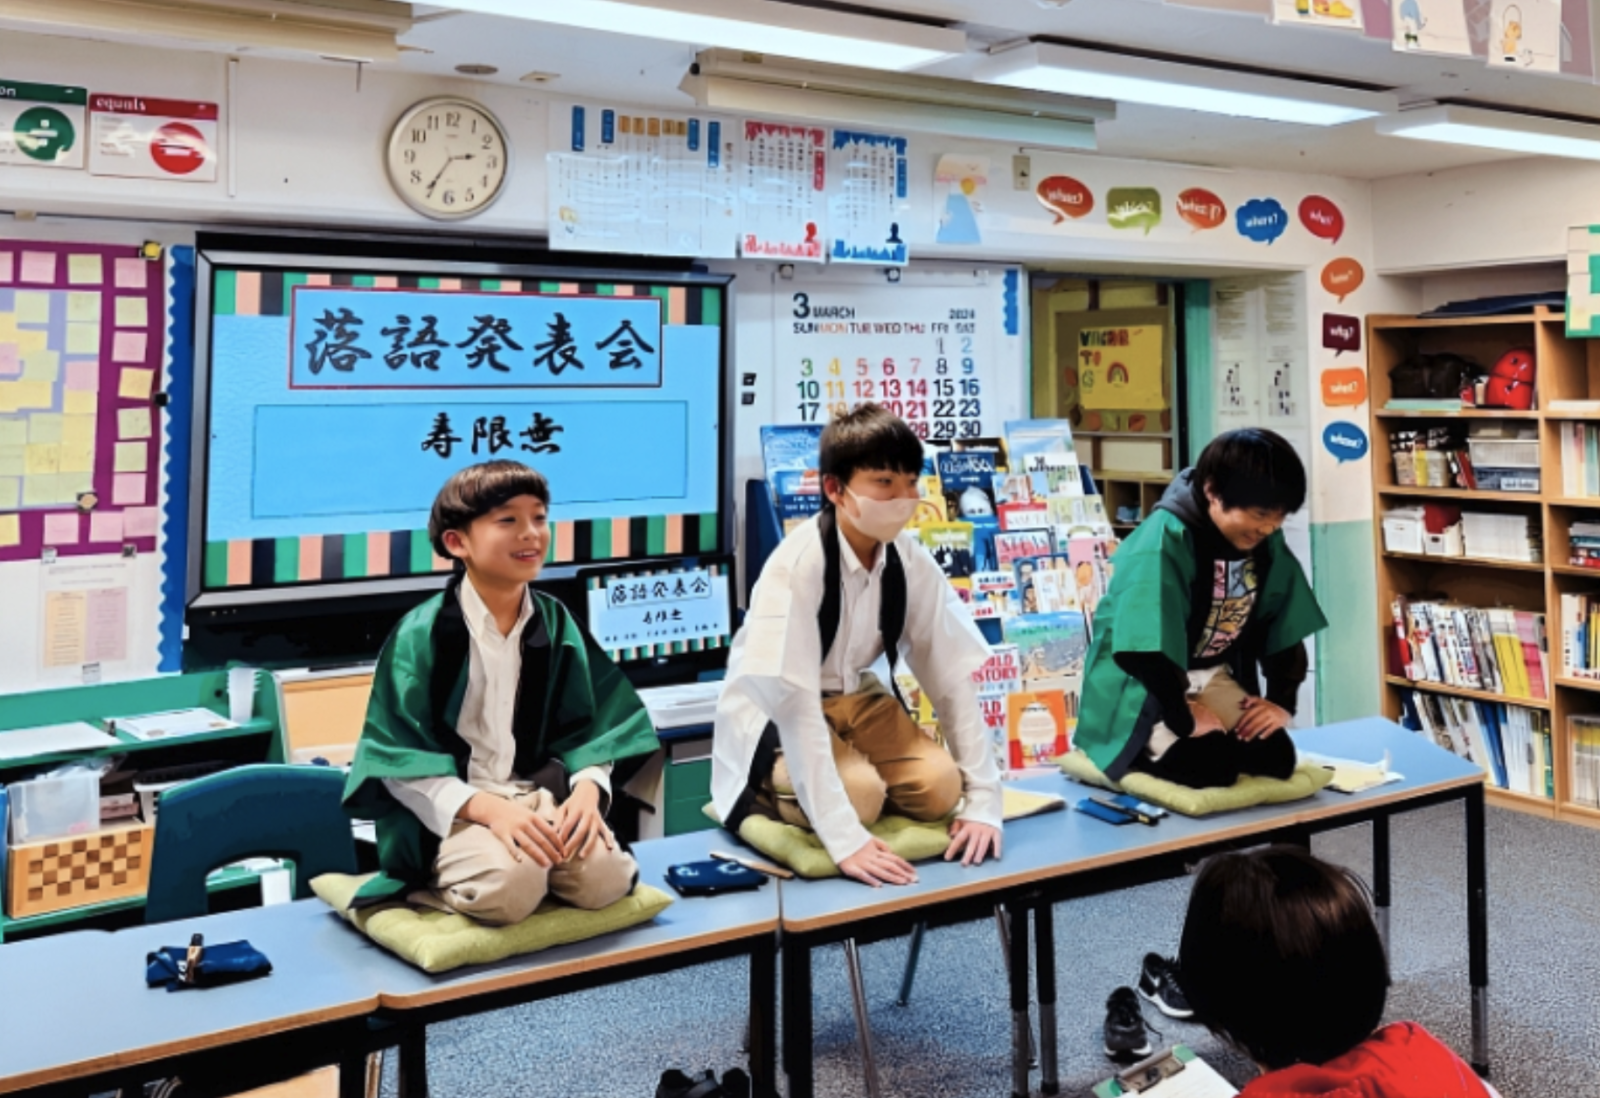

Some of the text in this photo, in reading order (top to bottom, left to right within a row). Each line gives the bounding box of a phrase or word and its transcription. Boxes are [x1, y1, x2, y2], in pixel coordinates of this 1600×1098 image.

[96, 97, 146, 111] equals
[427, 114, 439, 130] 11
[445, 111, 461, 128] 12
[411, 128, 426, 144] 10
[442, 189, 455, 206] 6
[792, 291, 811, 320] 3
[813, 306, 856, 320] MARCH
[793, 322, 819, 335] SUN
[819, 322, 849, 335] MON
[850, 322, 872, 335] TUE
[873, 322, 902, 335] WED
[904, 322, 925, 335] THU
[931, 322, 950, 335] FRI
[1329, 324, 1355, 341] why?
[305, 307, 655, 376] 落語発表会
[936, 336, 973, 355] 1 2
[800, 357, 974, 377] 3 4 5 6 7 8 9
[797, 378, 981, 400] 10 11 12 13 14 15 16
[797, 402, 821, 422] 17
[906, 400, 928, 419] 21
[933, 399, 956, 418] 22
[959, 399, 982, 418] 23
[421, 411, 564, 458] 寿限無
[933, 421, 957, 439] 29
[959, 420, 982, 439] 30
